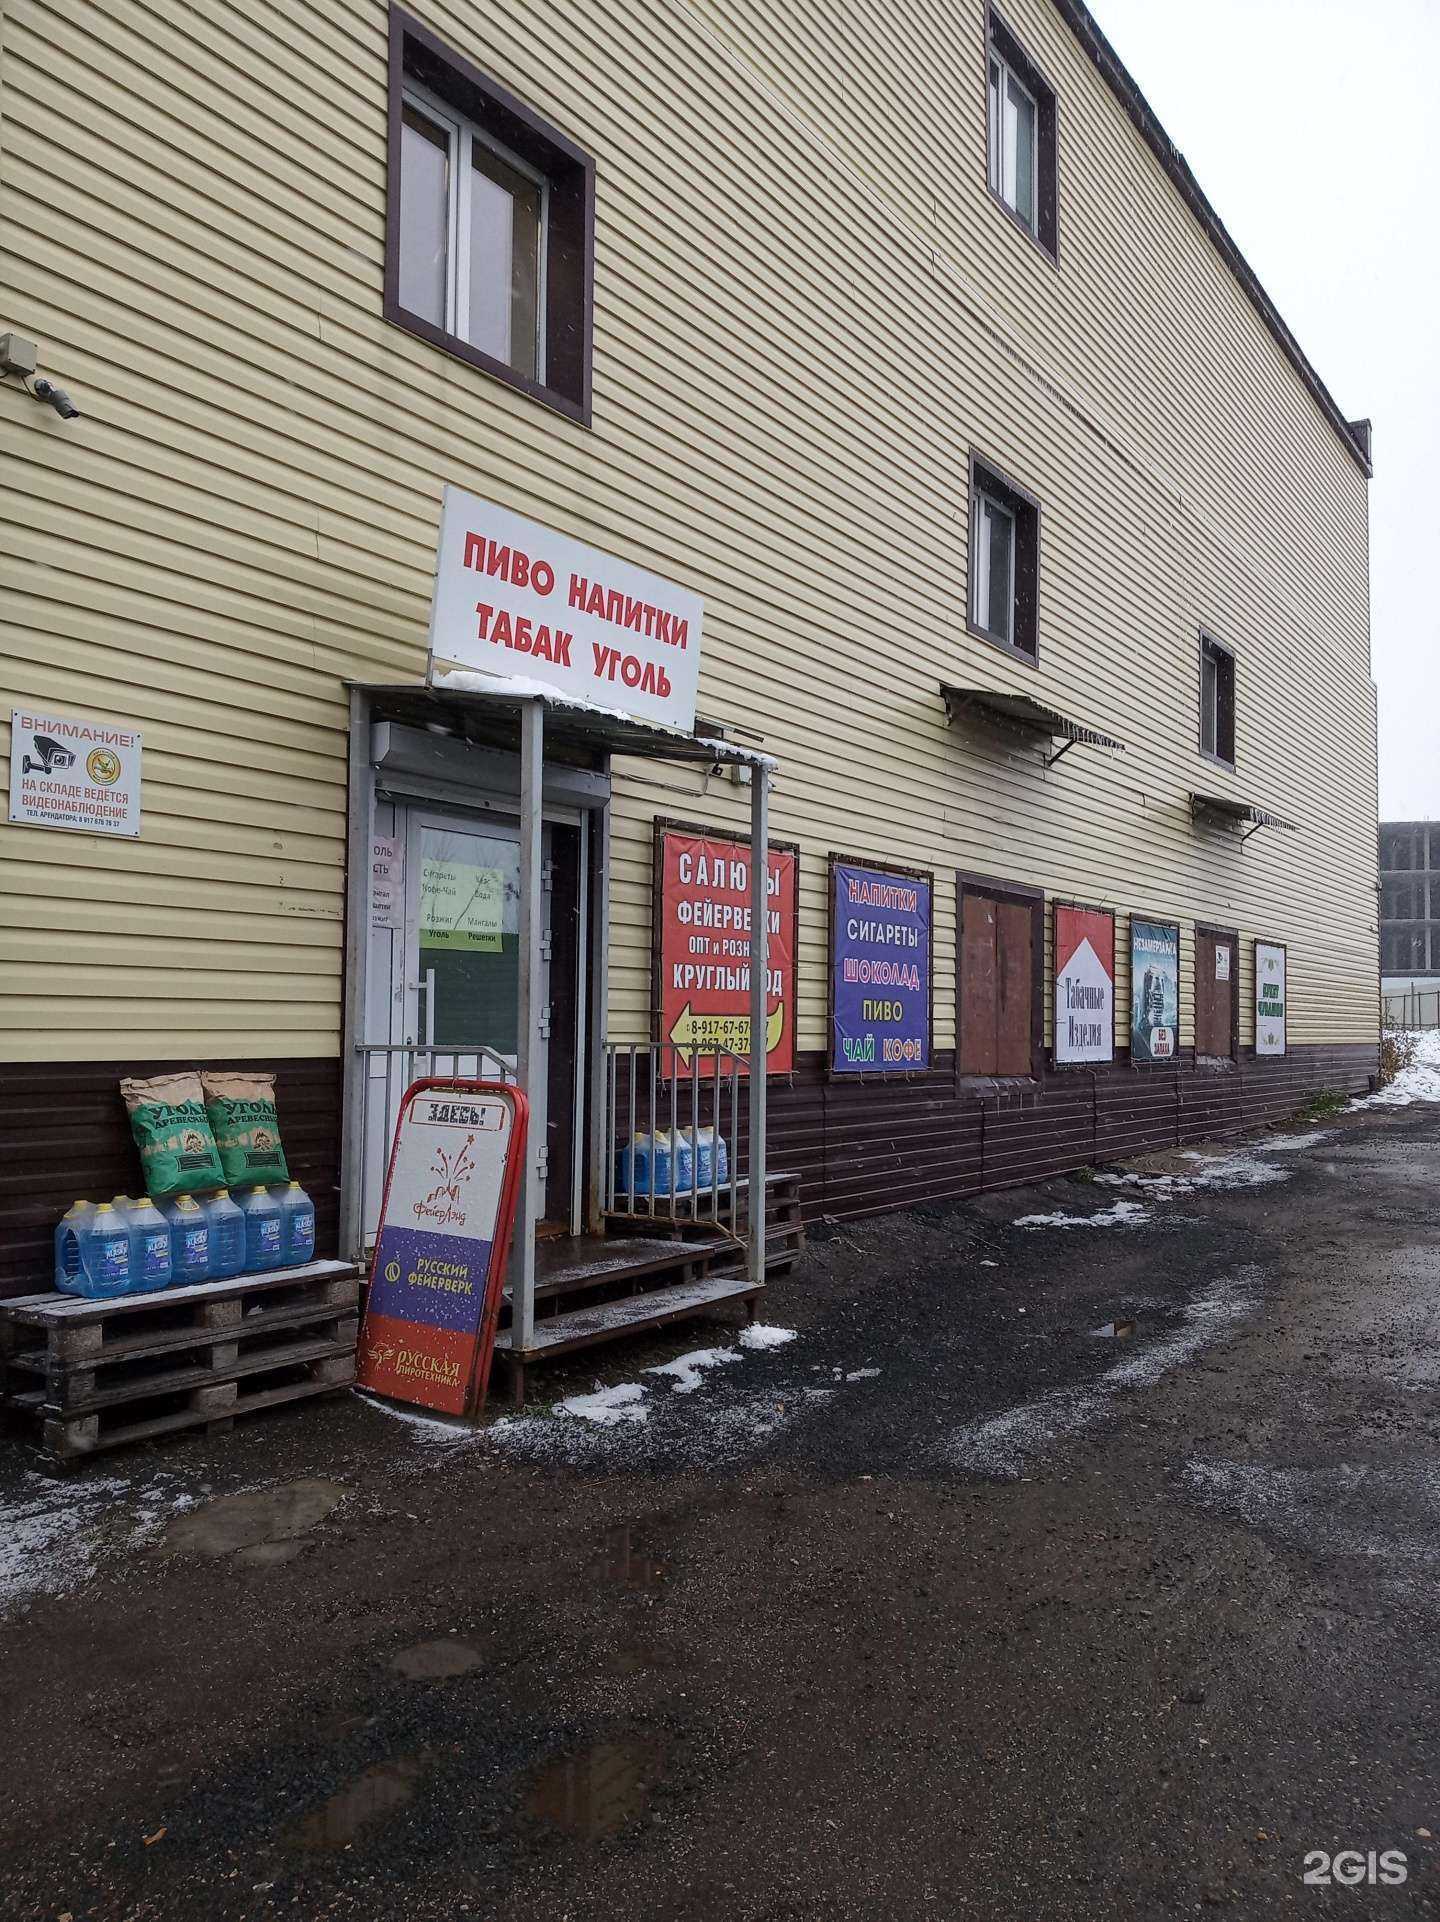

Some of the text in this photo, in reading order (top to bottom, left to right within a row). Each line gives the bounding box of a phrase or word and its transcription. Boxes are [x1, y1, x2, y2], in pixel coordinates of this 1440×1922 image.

[463, 530, 688, 650] ПИВО НАПИТКИ
[475, 602, 671, 698] ТАБАК УГОЛЬ
[21, 716, 134, 748] ВНИМАНИЕ!
[22, 778, 36, 791] НА
[40, 781, 81, 798] СКЛАДЕ
[22, 794, 127, 819] ВИДЕОНАБЛЮДЕНИЕ
[679, 853, 780, 897] САЛЮЫ
[848, 878, 917, 913] НАПИТКИ
[677, 899, 780, 934] ФЕЙЕРВЕКИ
[689, 935, 710, 955] ОПТ
[847, 918, 918, 948] СИГАРЕТЫ
[673, 962, 750, 992] КРУГЛЫЙ
[843, 957, 920, 991] ШОКОЛАД
[1065, 977, 1104, 1010] Табачные
[862, 999, 903, 1022] ПИВО
[842, 1034, 922, 1062] ЧАЙ КОФЕ
[1068, 1016, 1102, 1052] Изделия
[428, 1103, 487, 1126] ЗДЕСЬ!
[417, 1258, 468, 1278] РУССКИЙ
[408, 1272, 473, 1295] ФЕЙЕРВЕРК
[394, 1350, 461, 1376] РУССКАЯ
[399, 1365, 461, 1387] ПИРОТЕХНИКА
